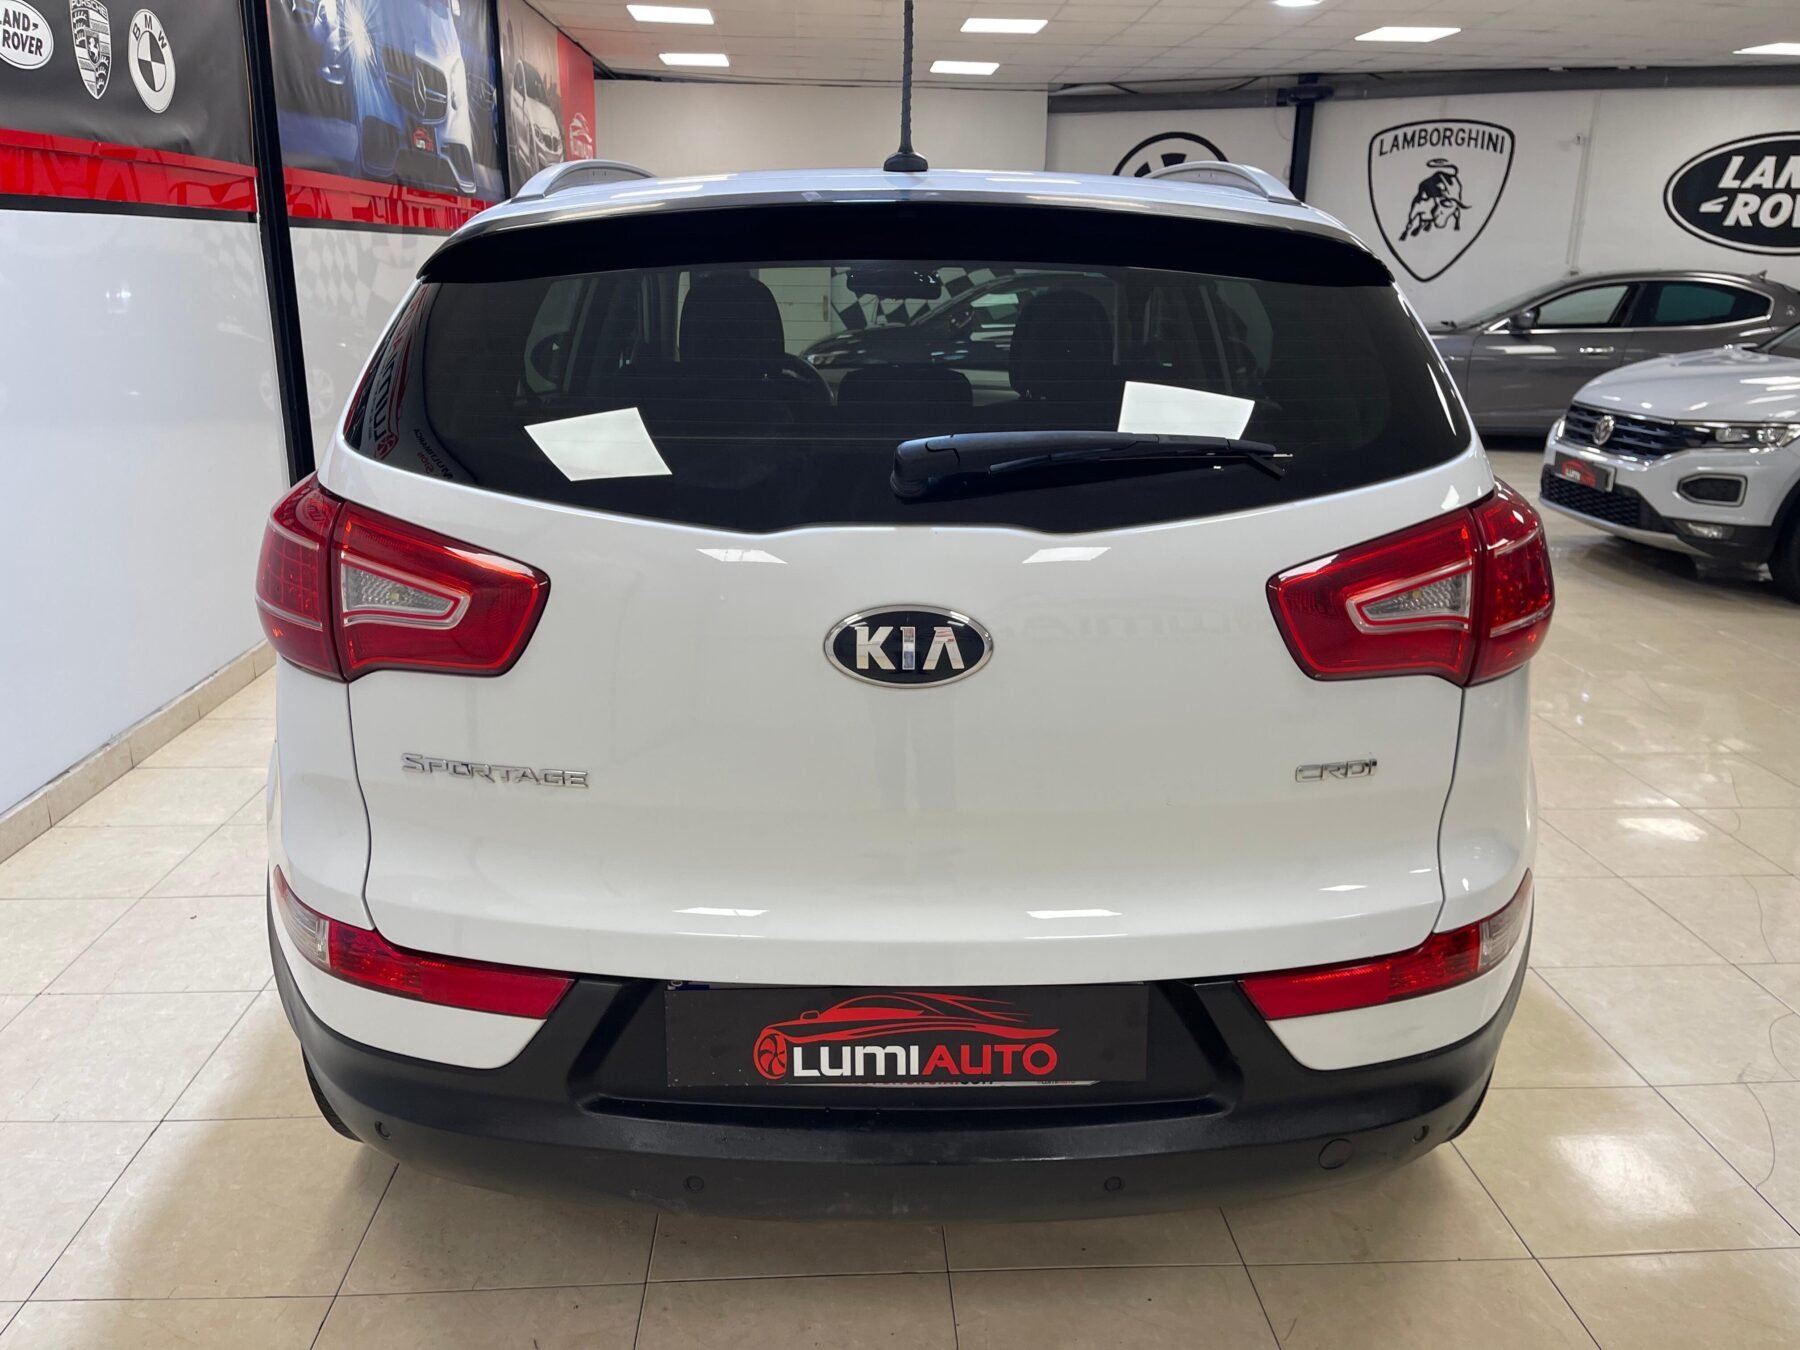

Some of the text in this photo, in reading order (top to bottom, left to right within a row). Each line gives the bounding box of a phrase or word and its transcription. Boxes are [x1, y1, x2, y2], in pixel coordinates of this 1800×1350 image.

[0, 7, 30, 32] AND
[132, 13, 167, 49] BMW
[2, 28, 43, 57] ROVER
[1378, 127, 1506, 157] LAMBORGHINI
[854, 626, 965, 670] KIA
[401, 752, 589, 788] SPORTAGE
